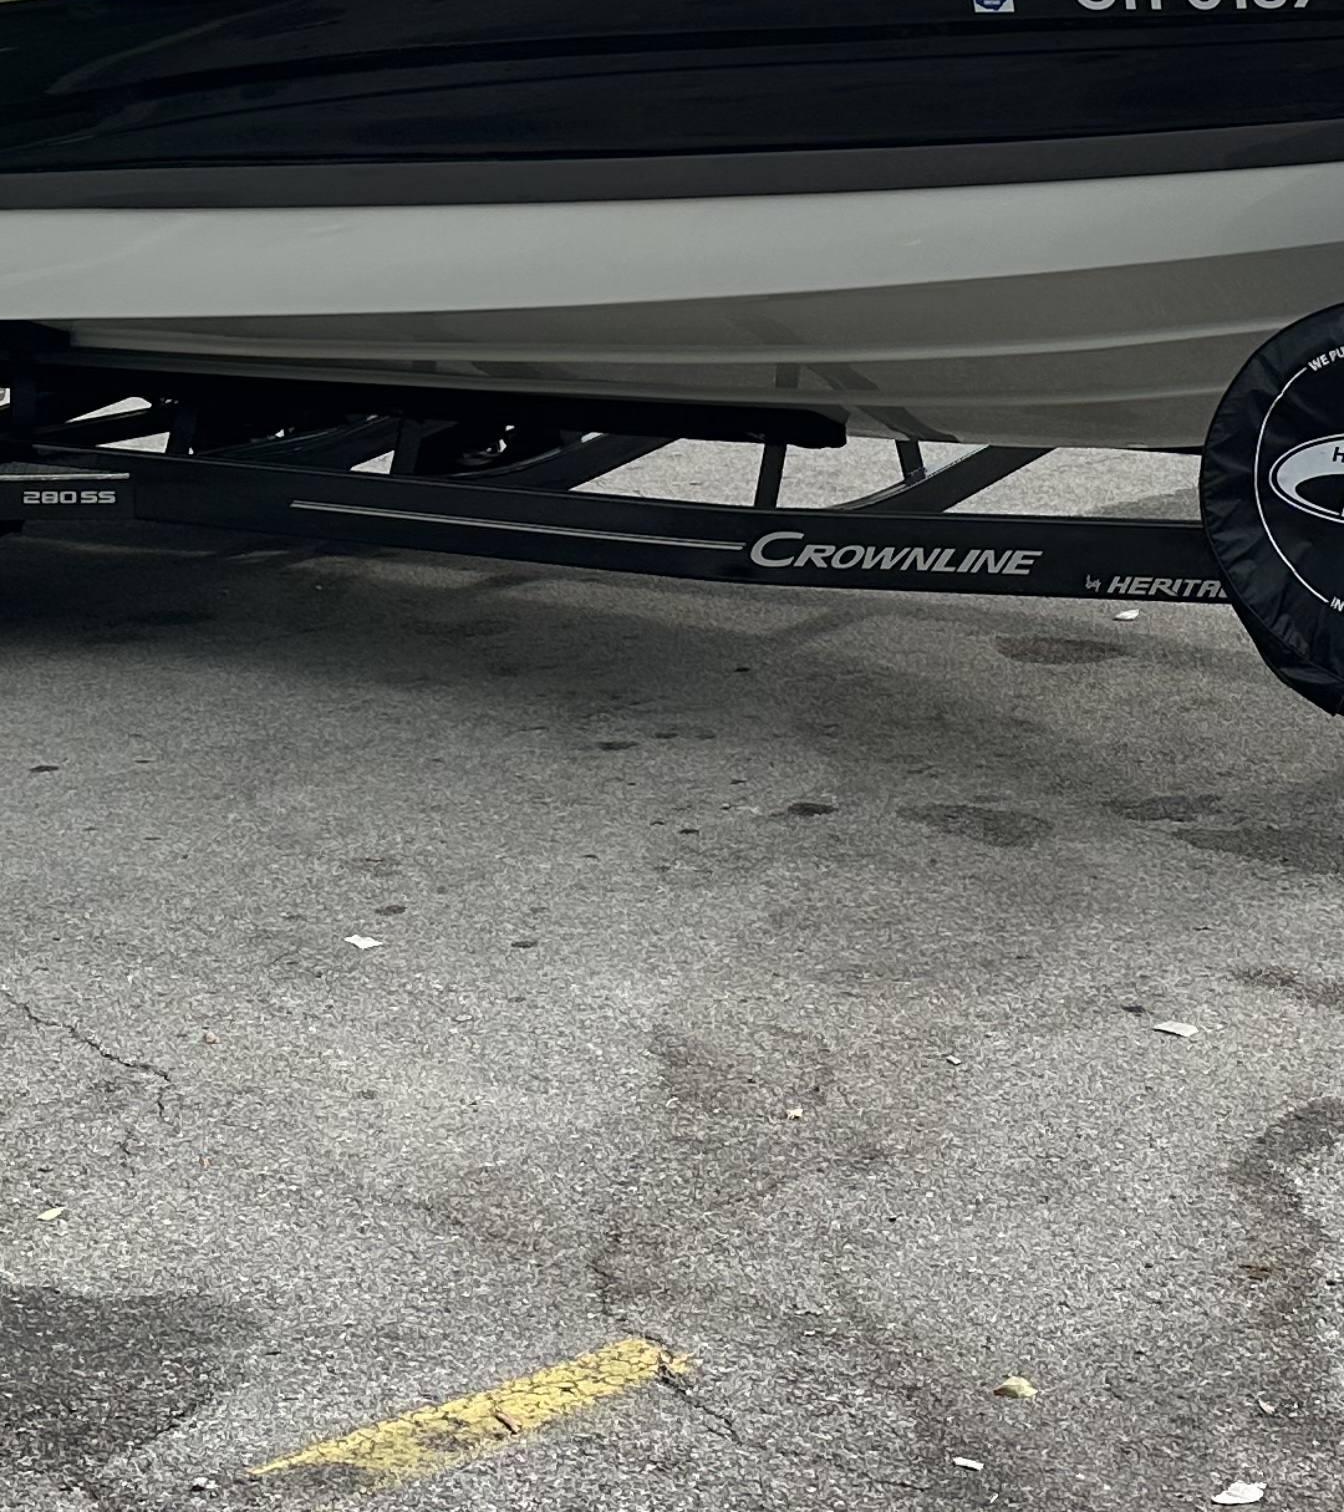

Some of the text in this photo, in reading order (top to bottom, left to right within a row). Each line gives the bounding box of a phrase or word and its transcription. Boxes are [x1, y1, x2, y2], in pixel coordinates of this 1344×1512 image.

[1308, 354, 1330, 371] WE
[23, 491, 116, 504] 280 SS
[750, 531, 1043, 575] CROWNLINE
[1107, 576, 1228, 598] HERITA
[1330, 596, 1344, 612] IN
